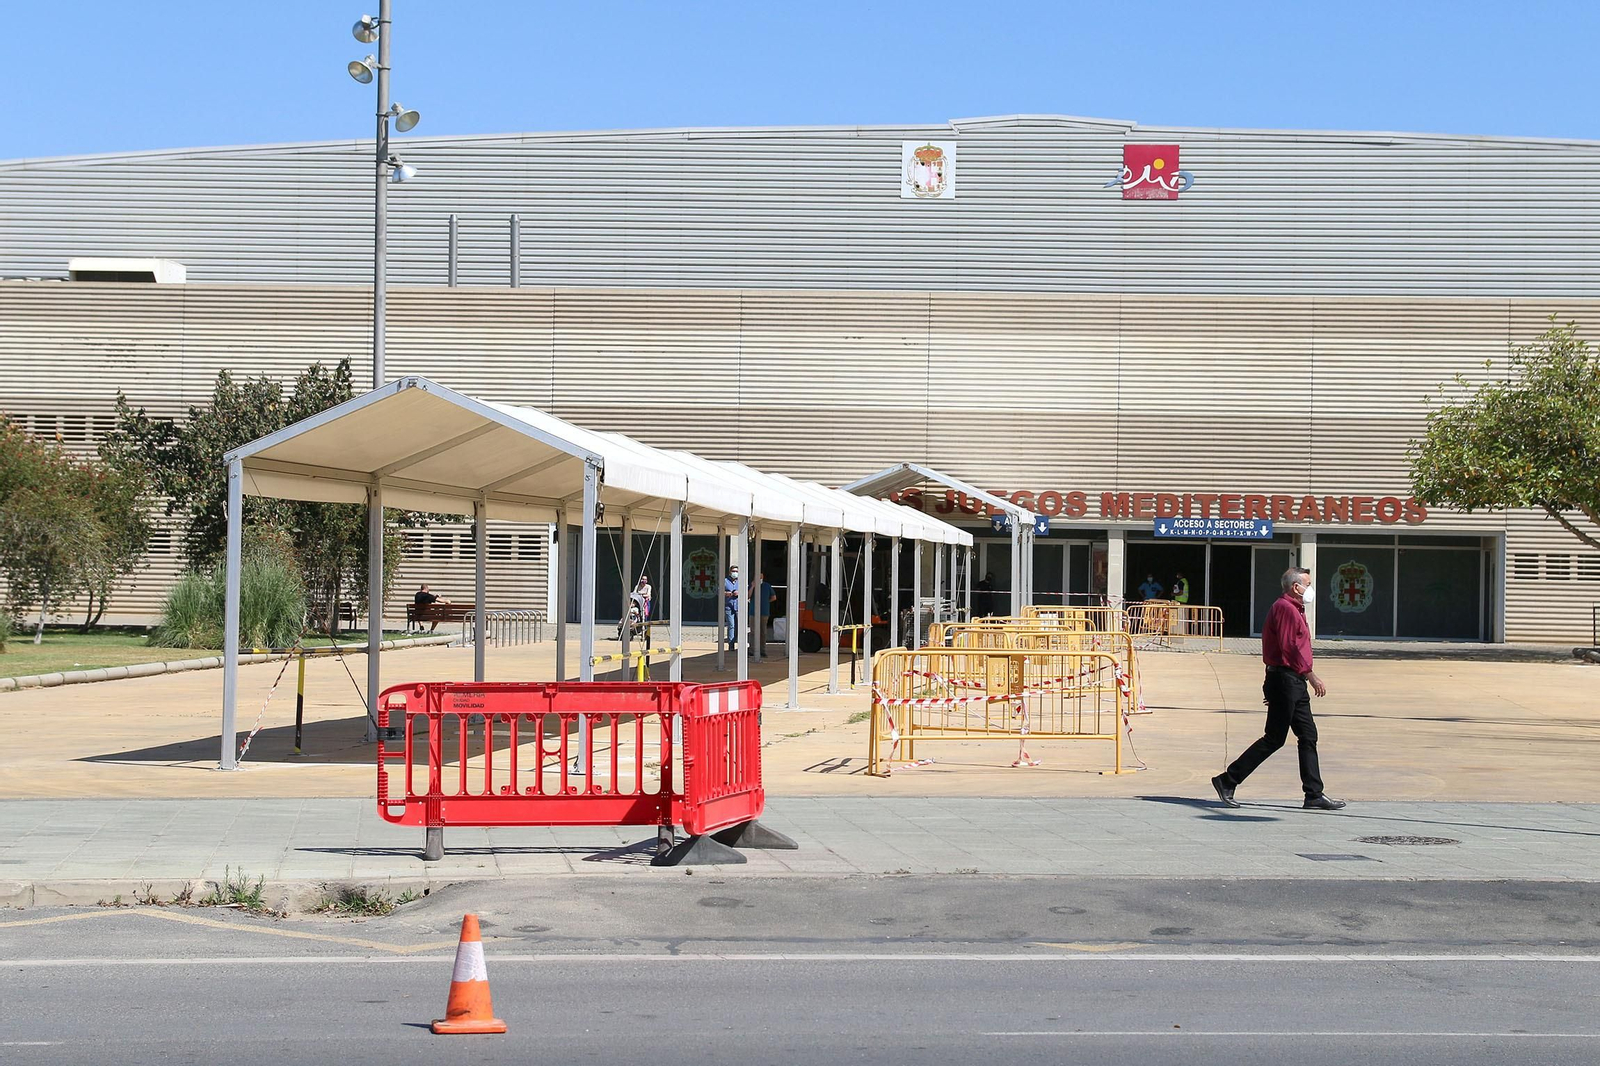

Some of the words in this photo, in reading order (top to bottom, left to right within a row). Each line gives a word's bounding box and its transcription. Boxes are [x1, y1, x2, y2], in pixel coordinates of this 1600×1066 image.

[935, 489, 1087, 517] JUEGOS
[1101, 492, 1427, 525] MEDITERRANEOS
[1173, 519, 1204, 528] ACCESO
[1207, 520, 1212, 528] A
[1214, 520, 1255, 529] SECTORES
